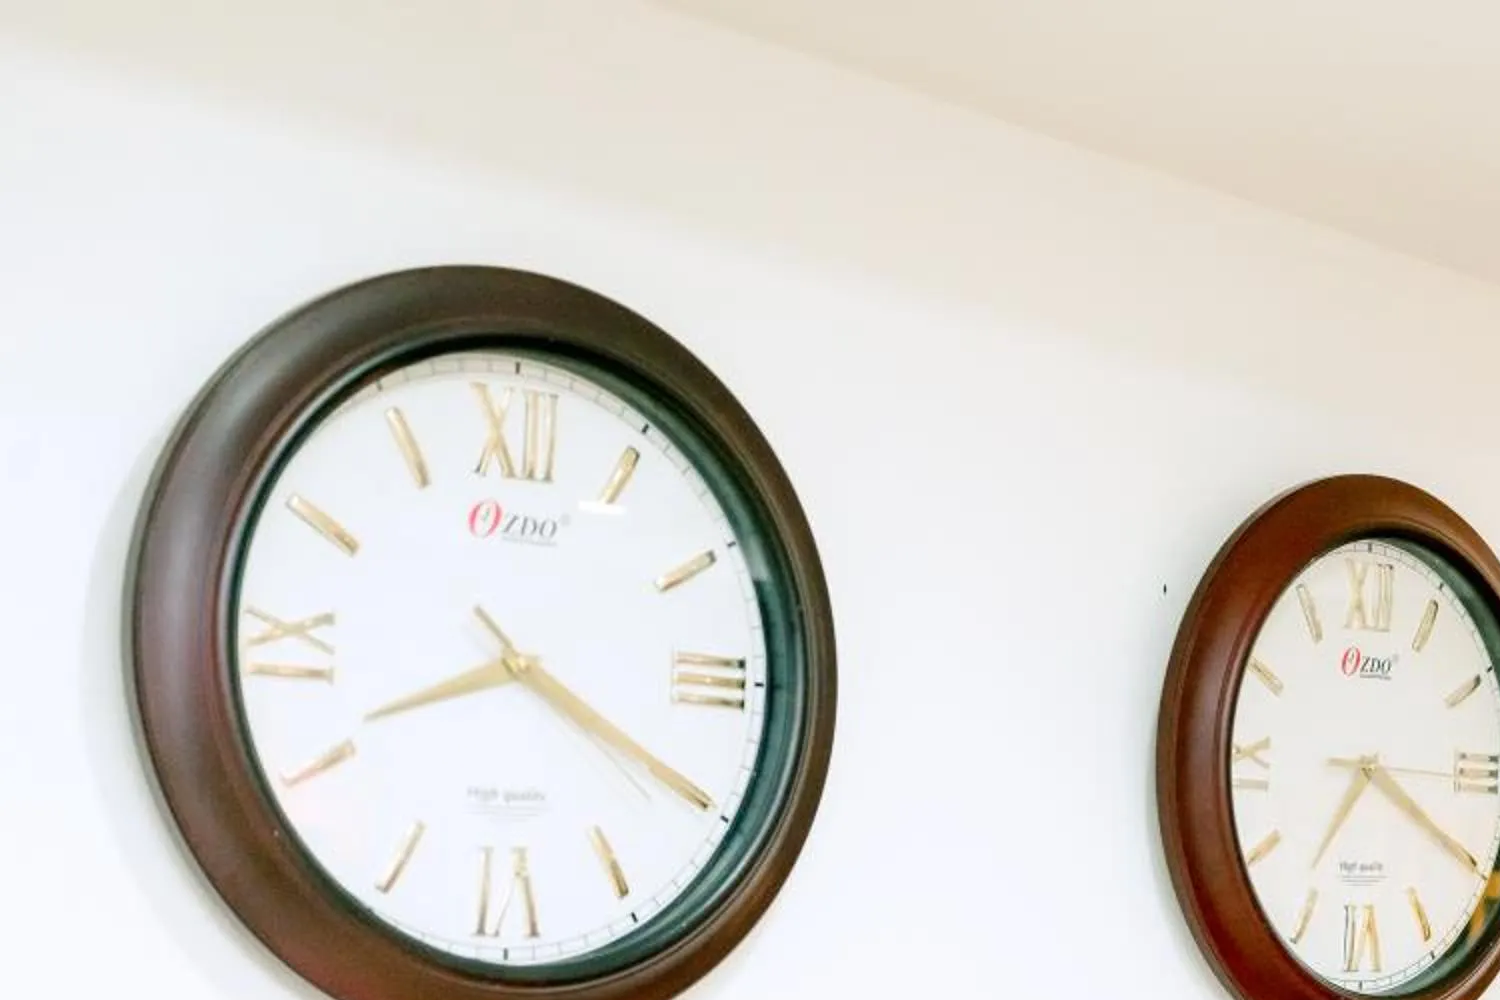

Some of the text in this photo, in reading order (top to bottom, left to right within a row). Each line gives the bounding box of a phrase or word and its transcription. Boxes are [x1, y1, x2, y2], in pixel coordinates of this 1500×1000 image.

[471, 382, 559, 482] XII
[1344, 558, 1395, 632] XII
[672, 651, 746, 710] III
[1340, 645, 1391, 676] OZDO
[1453, 748, 1499, 794] III
